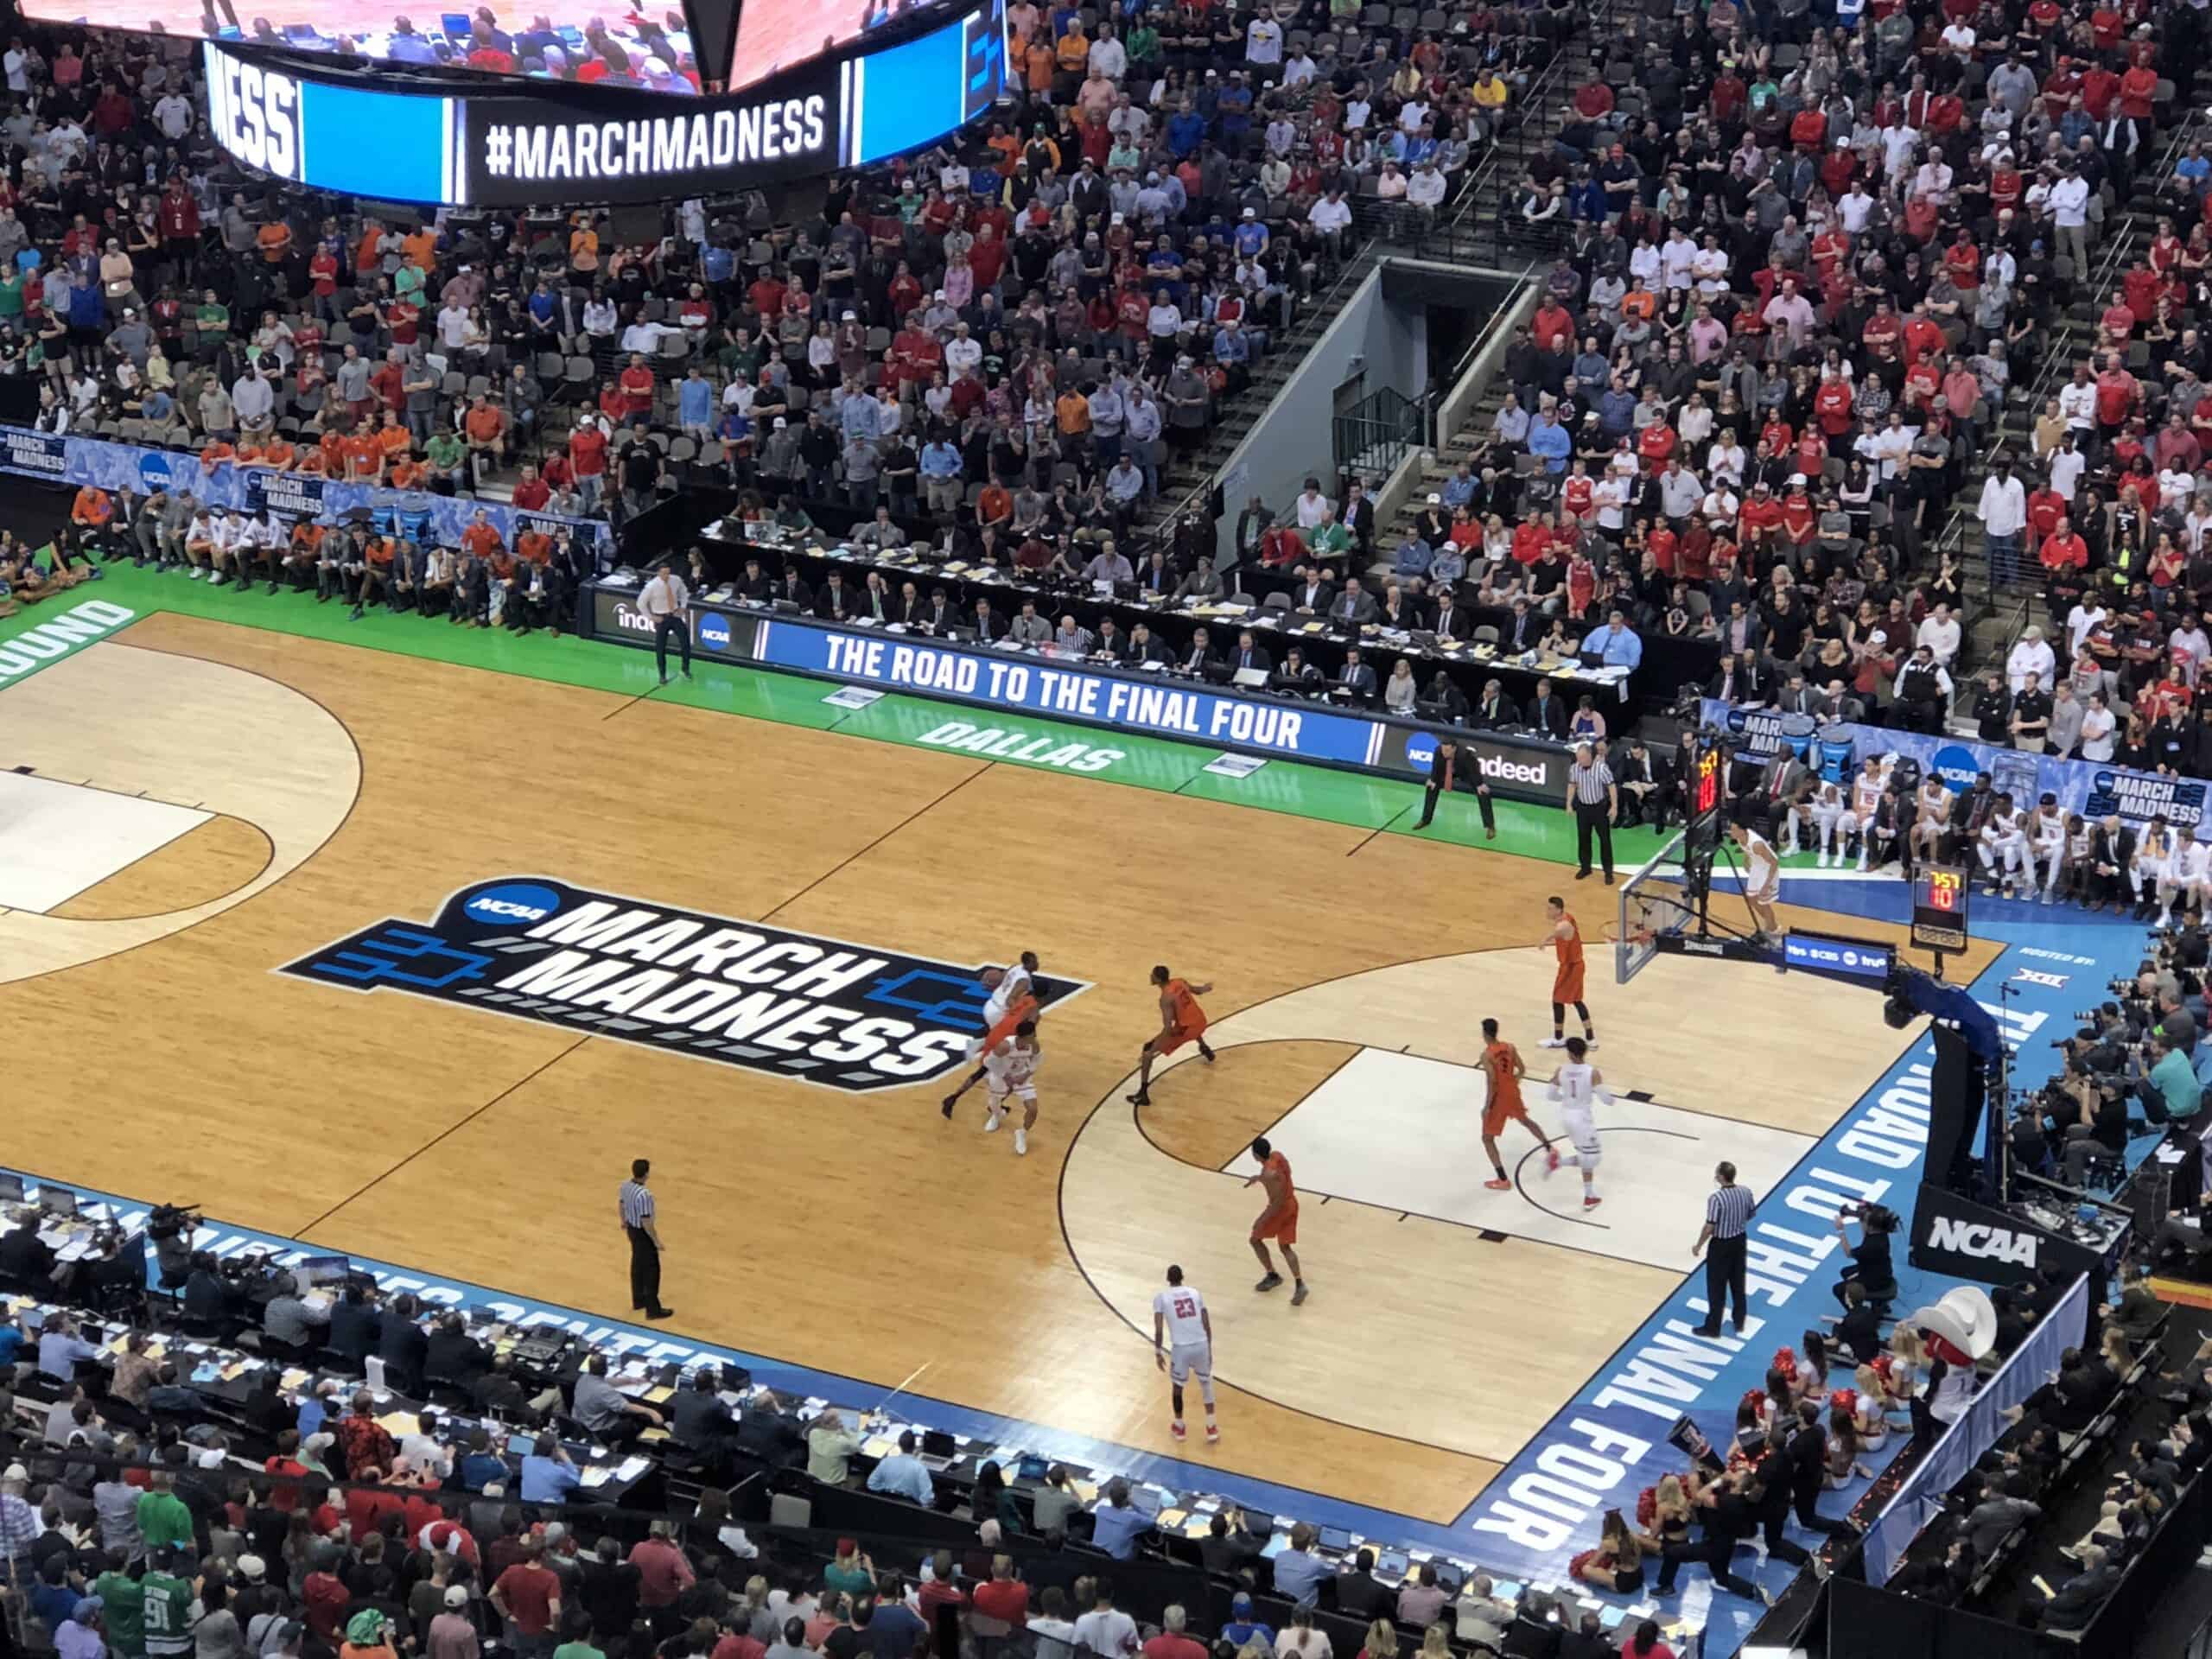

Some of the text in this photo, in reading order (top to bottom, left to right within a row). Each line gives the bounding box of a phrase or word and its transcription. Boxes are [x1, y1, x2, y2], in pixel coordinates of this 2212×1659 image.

[486, 95, 824, 178] #MARCHMADNESS
[7, 434, 45, 452] MARCH
[12, 448, 66, 471] MADNESS
[261, 475, 302, 493] MARCH
[266, 492, 323, 513] MADNESS
[531, 518, 574, 539] MARH
[0, 600, 135, 683] OUND
[826, 635, 1302, 749] THE ROAD TO THE FINAL FOUR
[1744, 715, 1783, 736] MAR
[915, 721, 1127, 772] DALLAS
[1408, 749, 1433, 762] NCA
[1477, 755, 1546, 785] ndeed
[2113, 776, 2176, 802] MARCH
[2119, 796, 2202, 824] MADNESS
[469, 898, 548, 921] NCAA
[1933, 888, 1953, 909] 10
[524, 901, 890, 998] MARCH
[2018, 946, 2073, 963] HOSTED
[493, 950, 975, 1076] MADNESS
[1784, 1166, 1892, 1224] TO
[1928, 1216, 2037, 1269] NCAA
[1746, 1222, 1841, 1307] THE
[1173, 1297, 1197, 1319] 23
[1471, 1417, 1653, 1552] FOUR
[144, 1598, 171, 1631] 91
